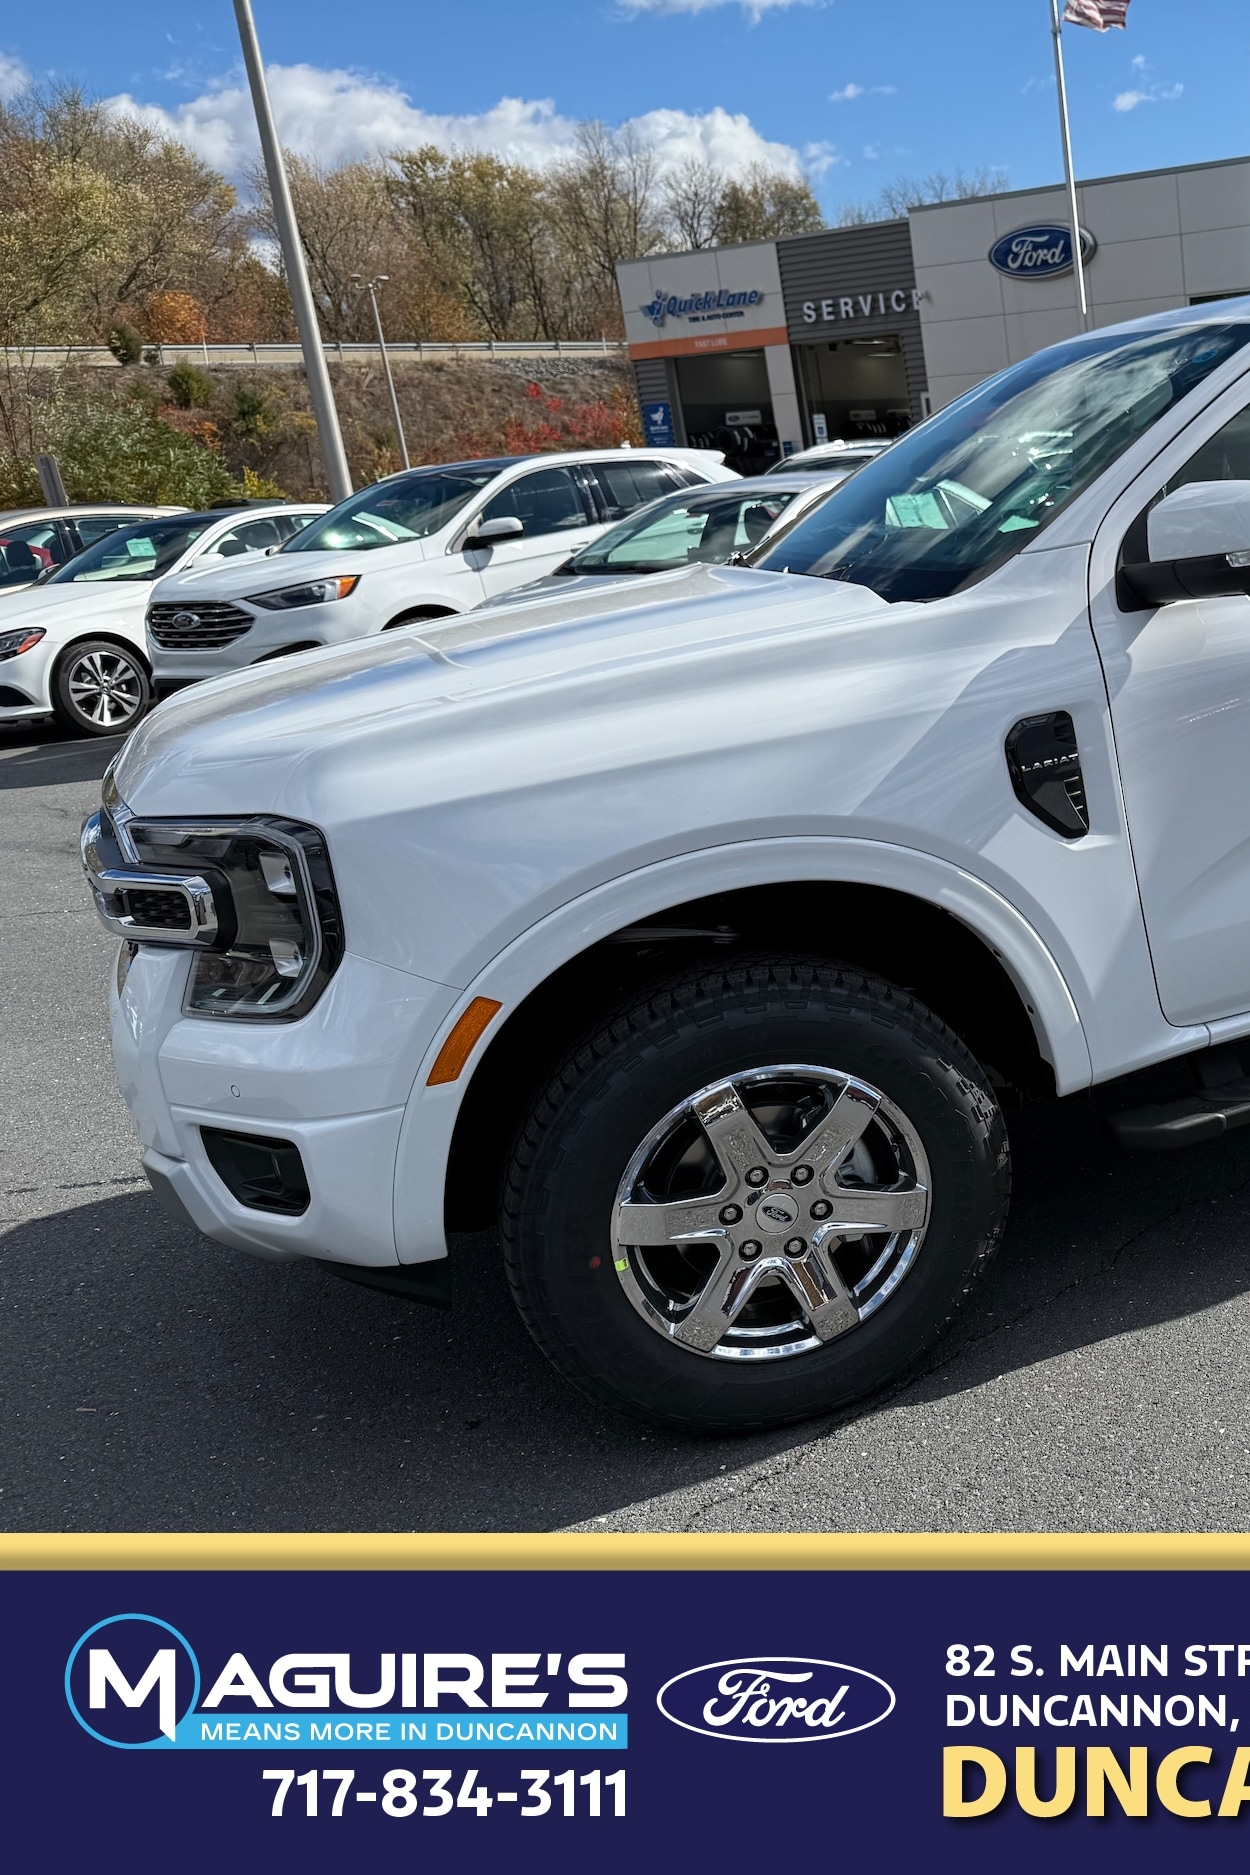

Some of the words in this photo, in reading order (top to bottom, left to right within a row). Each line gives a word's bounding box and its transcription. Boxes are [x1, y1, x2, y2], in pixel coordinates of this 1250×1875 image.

[1007, 235, 1065, 270] Ford
[667, 292, 715, 317] Quick
[716, 289, 760, 309] Lane
[803, 289, 924, 323] SERVICE
[1021, 752, 1079, 772] LARIAT
